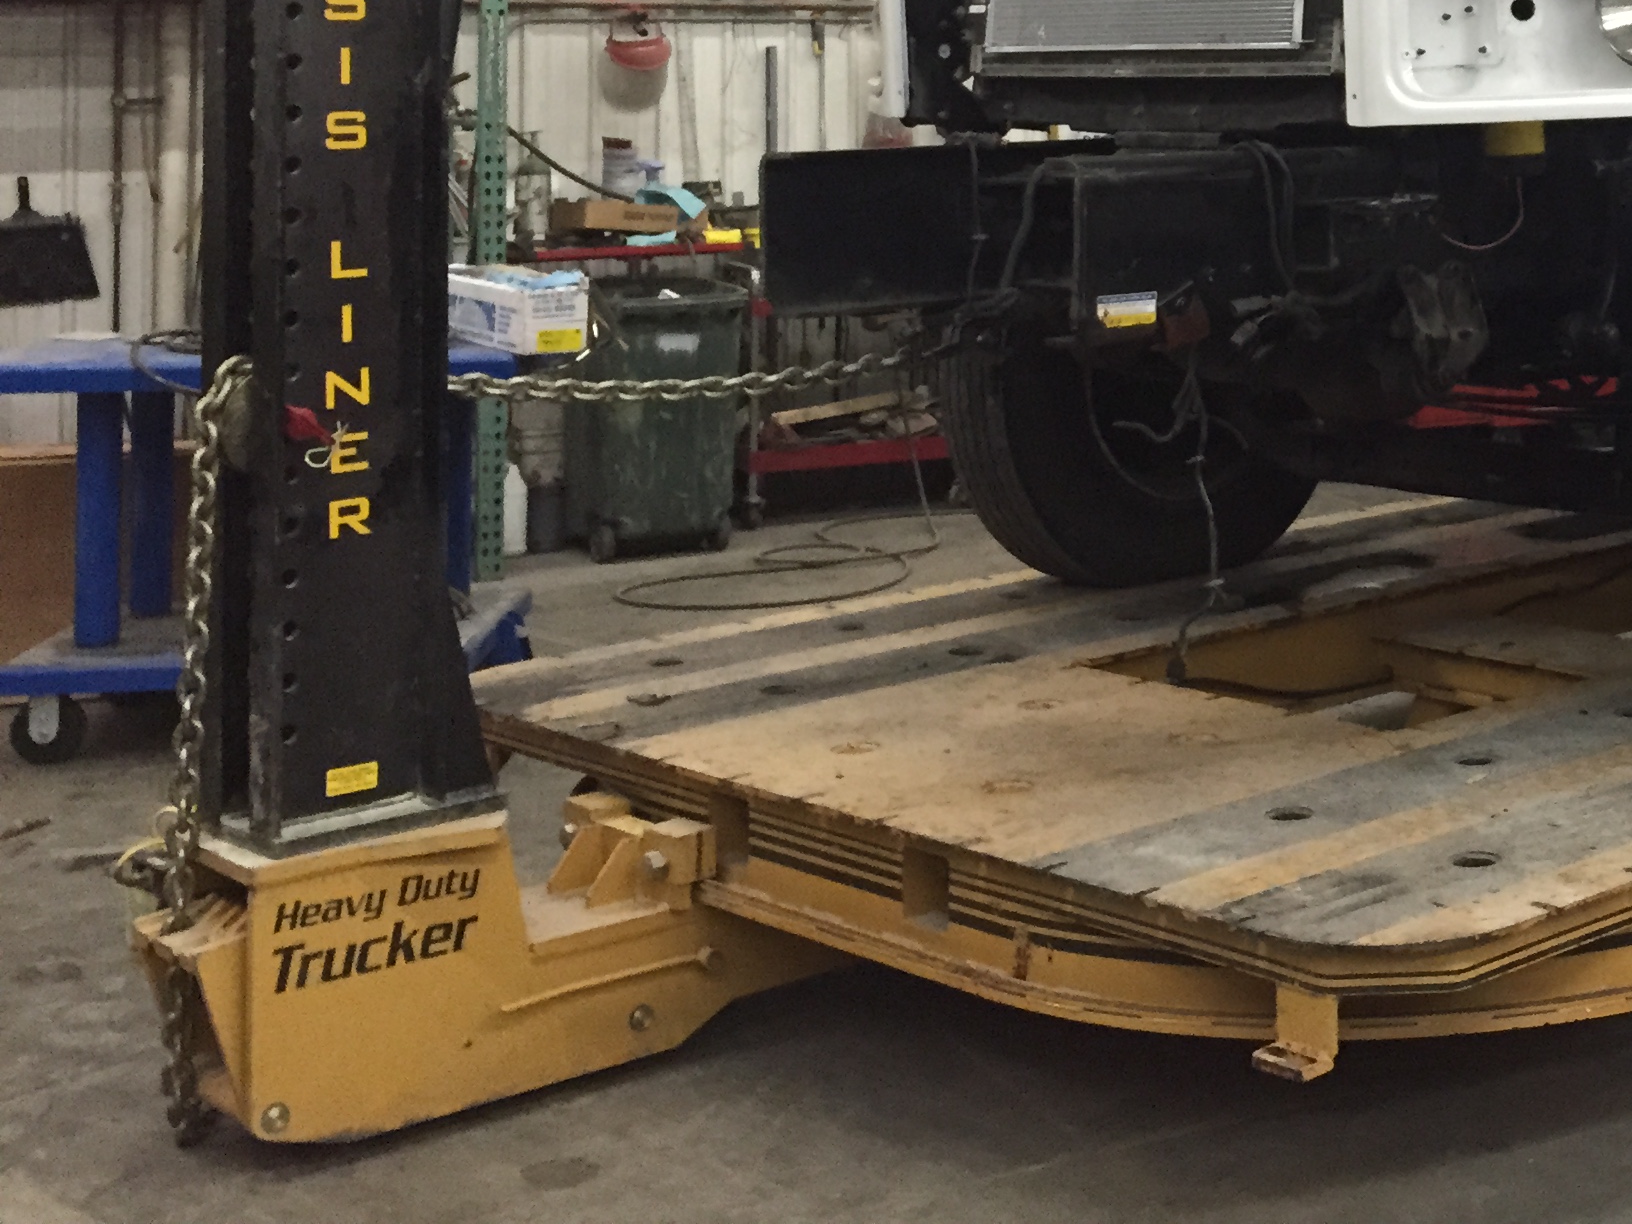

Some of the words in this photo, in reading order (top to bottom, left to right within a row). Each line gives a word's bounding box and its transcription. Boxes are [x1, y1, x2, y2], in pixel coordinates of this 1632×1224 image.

[325, 240, 372, 540] LINER
[273, 889, 387, 934] Heavy
[397, 868, 480, 907] Duty
[272, 914, 479, 995] Trucker
